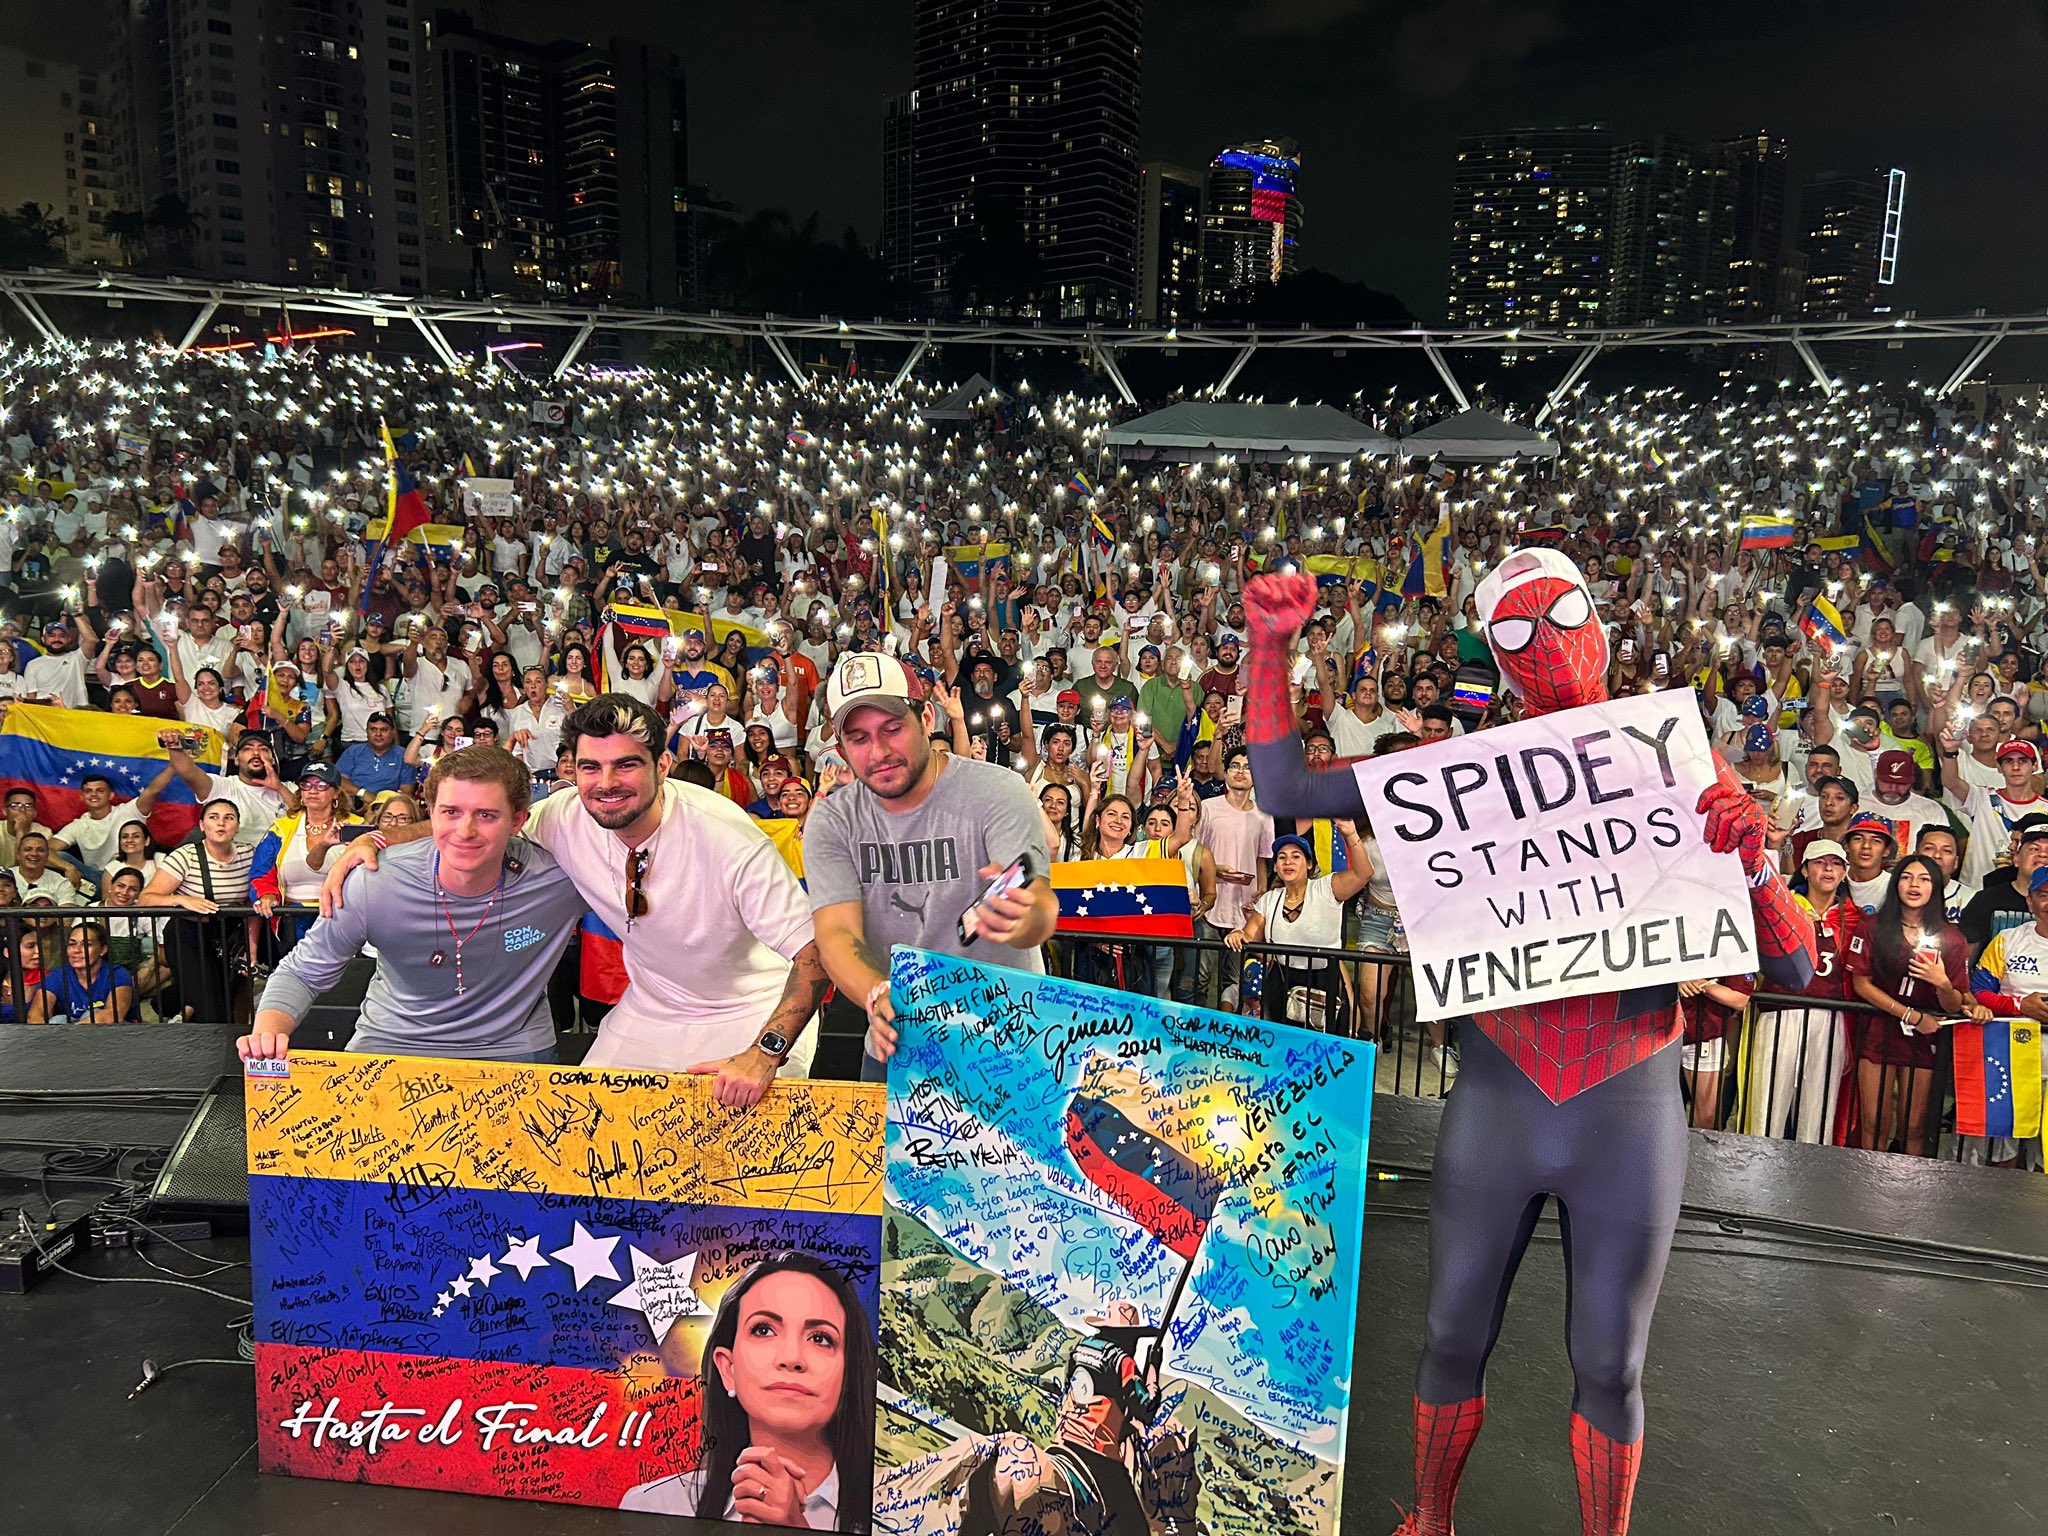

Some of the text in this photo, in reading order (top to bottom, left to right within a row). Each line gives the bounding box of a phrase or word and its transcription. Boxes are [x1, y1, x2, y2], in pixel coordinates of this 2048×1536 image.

[1383, 717, 1679, 842] SPIDEY
[860, 836, 960, 885] PUMA
[1427, 807, 1681, 888] STANDS
[1486, 873, 1624, 928] WITH
[504, 926, 531, 938] CON
[505, 933, 546, 952] CORINA
[1422, 909, 1749, 1007] VENEZUELA
[1815, 951, 1835, 977] 3
[2009, 955, 2037, 965] CON
[899, 966, 988, 1005] VENEZUELA
[250, 1062, 285, 1071] MCM EGU
[1044, 1011, 1134, 1083] Génesis
[1118, 1038, 1161, 1058] 2024
[628, 1095, 686, 1131] Venezuela
[1240, 1051, 1355, 1141] VENEZUELA
[905, 1139, 968, 1170] BETA
[280, 1396, 426, 1454] Hasta
[418, 1398, 462, 1446] el
[474, 1400, 610, 1452] Final
